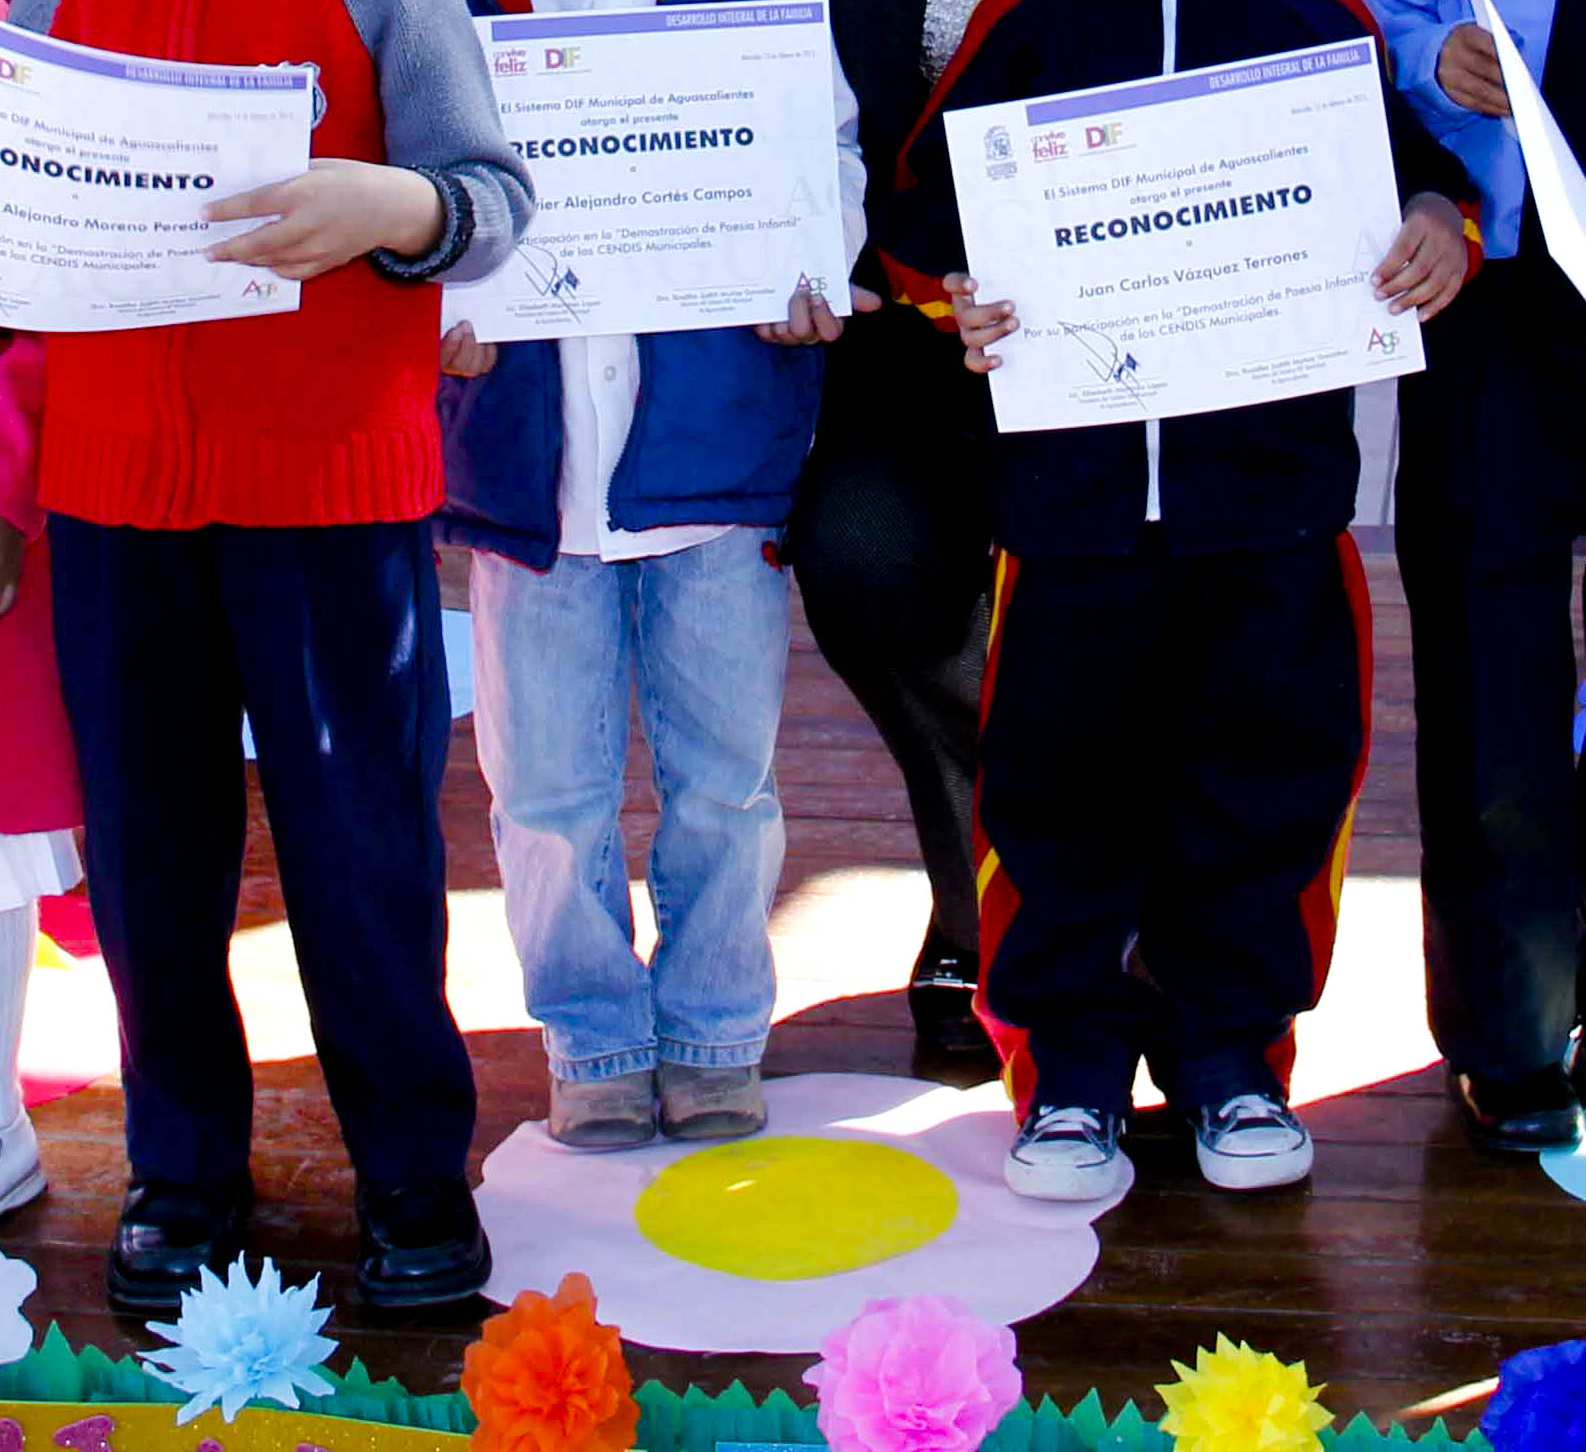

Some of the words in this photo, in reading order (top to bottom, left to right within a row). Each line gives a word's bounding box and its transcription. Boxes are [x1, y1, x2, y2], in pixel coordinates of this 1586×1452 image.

[493, 57, 527, 75] feliz
[543, 46, 581, 70] DIF
[1209, 67, 1261, 89] DESARROLLO
[1262, 61, 1301, 78] INTEGRAL
[1301, 57, 1313, 71] DE
[1314, 55, 1326, 70] LA
[1326, 49, 1360, 66] FAMILIA
[500, 102, 512, 114] El
[514, 102, 561, 113] Sistema
[564, 98, 584, 110] DIF
[587, 94, 646, 108] Municipal
[648, 93, 664, 105] de
[667, 90, 754, 105] Aguascalientes
[1084, 121, 1123, 150] DIF
[1032, 141, 1068, 162] feliz
[1043, 187, 1056, 200] El
[1058, 183, 1108, 198] Sistema
[1110, 175, 1133, 189] DIF
[1135, 163, 1197, 184] Municipal
[1199, 161, 1215, 173] de
[1218, 145, 1309, 170] Aguascalientes
[563, 192, 637, 210] Alejandro
[641, 189, 689, 204] Cortés
[692, 187, 753, 201] Campos
[1129, 191, 1167, 205] otorga
[1170, 187, 1181, 198] el
[1183, 179, 1232, 197] presente
[1054, 184, 1312, 247] RECONOCIMIENTO
[1078, 284, 1115, 299] Juan
[1119, 273, 1170, 292] Carlos
[1173, 263, 1240, 283] Vázquez
[1243, 249, 1309, 270] Terrones
[1367, 327, 1400, 355] Ags
